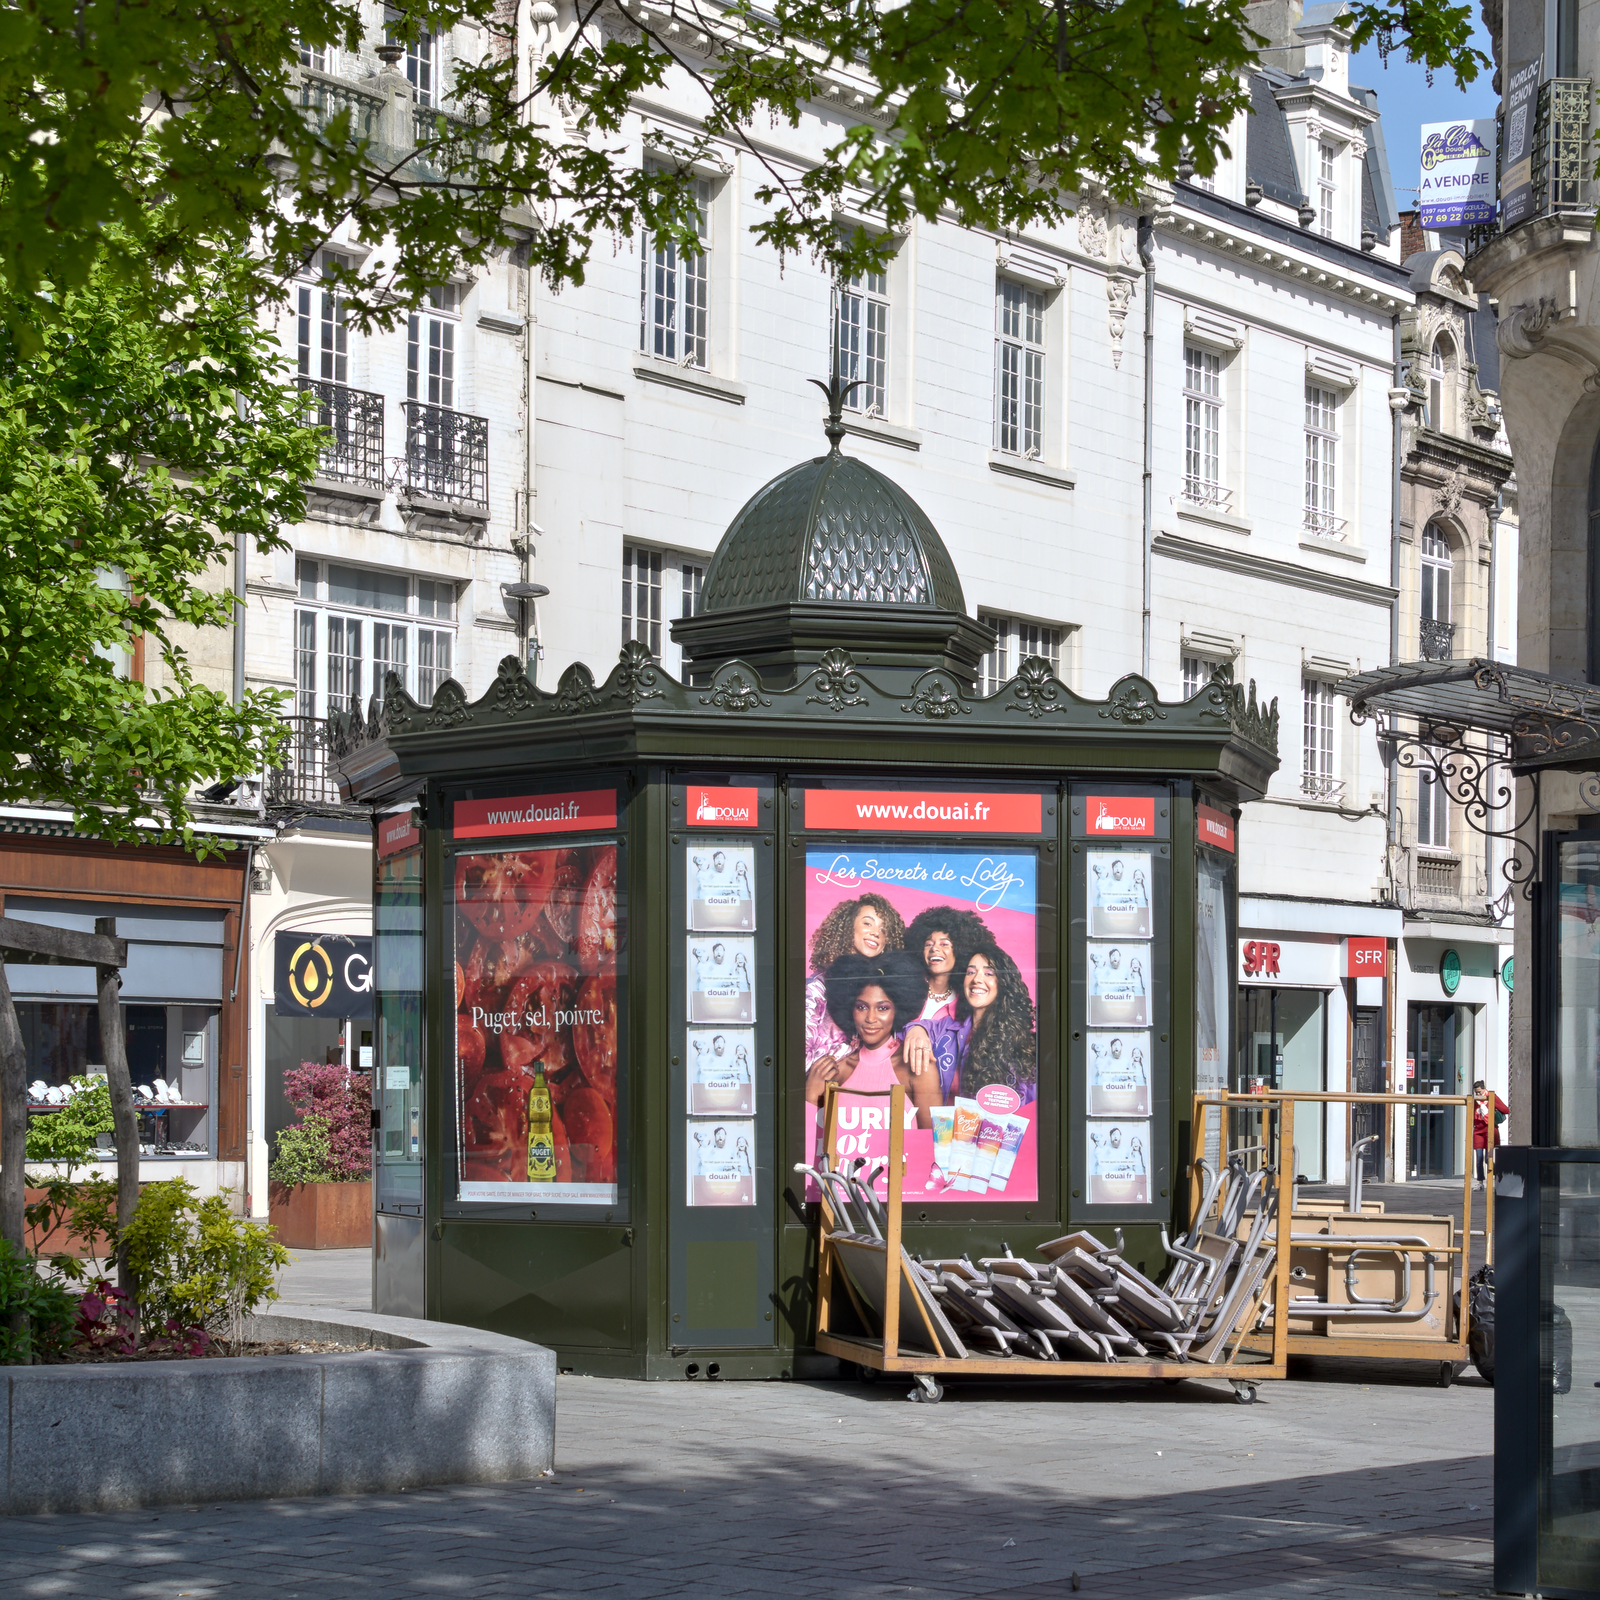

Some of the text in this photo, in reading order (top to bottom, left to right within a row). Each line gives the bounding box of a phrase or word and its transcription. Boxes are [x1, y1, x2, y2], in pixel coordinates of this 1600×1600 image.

[1509, 60, 1538, 92] NORLOC
[1510, 80, 1534, 109] RENOV
[1423, 125, 1473, 149] La Clé
[1422, 178, 1431, 189] A
[1434, 172, 1489, 188] VENDRE
[1422, 211, 1489, 223] 07 69 22 05 22
[487, 800, 580, 825] www.douai.fr
[715, 807, 749, 818] DOUAI
[856, 800, 990, 820] www.douai.fr
[1113, 817, 1145, 827] DOUAI
[386, 820, 411, 844] www.douai.fr
[815, 854, 1024, 911] Les Secrets de Loly
[1242, 941, 1281, 973] SFR
[1355, 950, 1382, 964] SFR
[344, 953, 373, 992] G
[471, 1004, 604, 1034] Puget, sel, poivre.
[962, 1123, 979, 1132] Curl
[531, 1148, 551, 1156] PUGET
